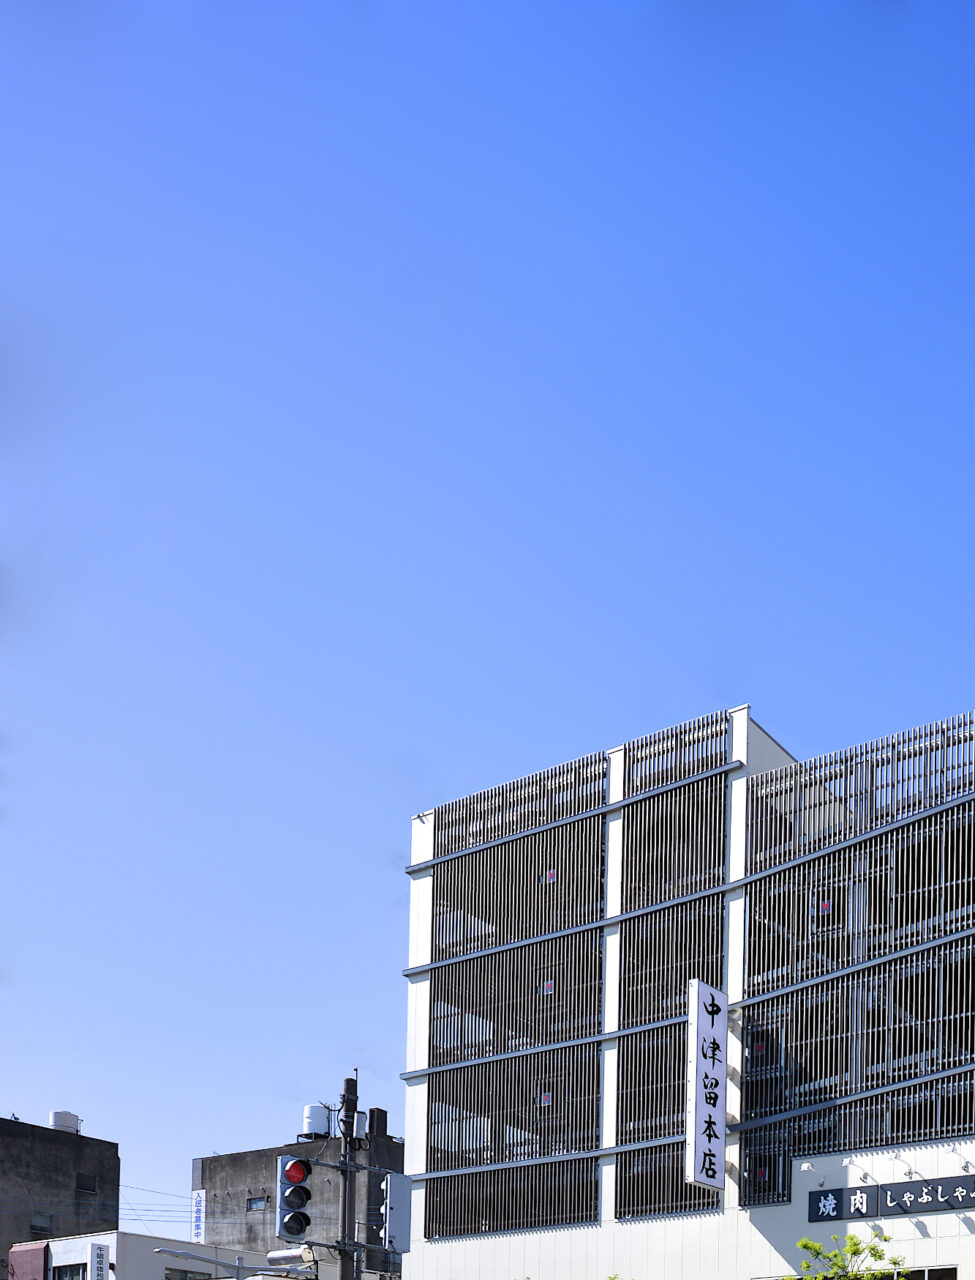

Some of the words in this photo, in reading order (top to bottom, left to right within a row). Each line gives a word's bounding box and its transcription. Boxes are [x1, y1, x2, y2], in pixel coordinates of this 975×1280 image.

[700, 993, 722, 1180] 中津留本店
[818, 1189, 868, 1217] 焼肉
